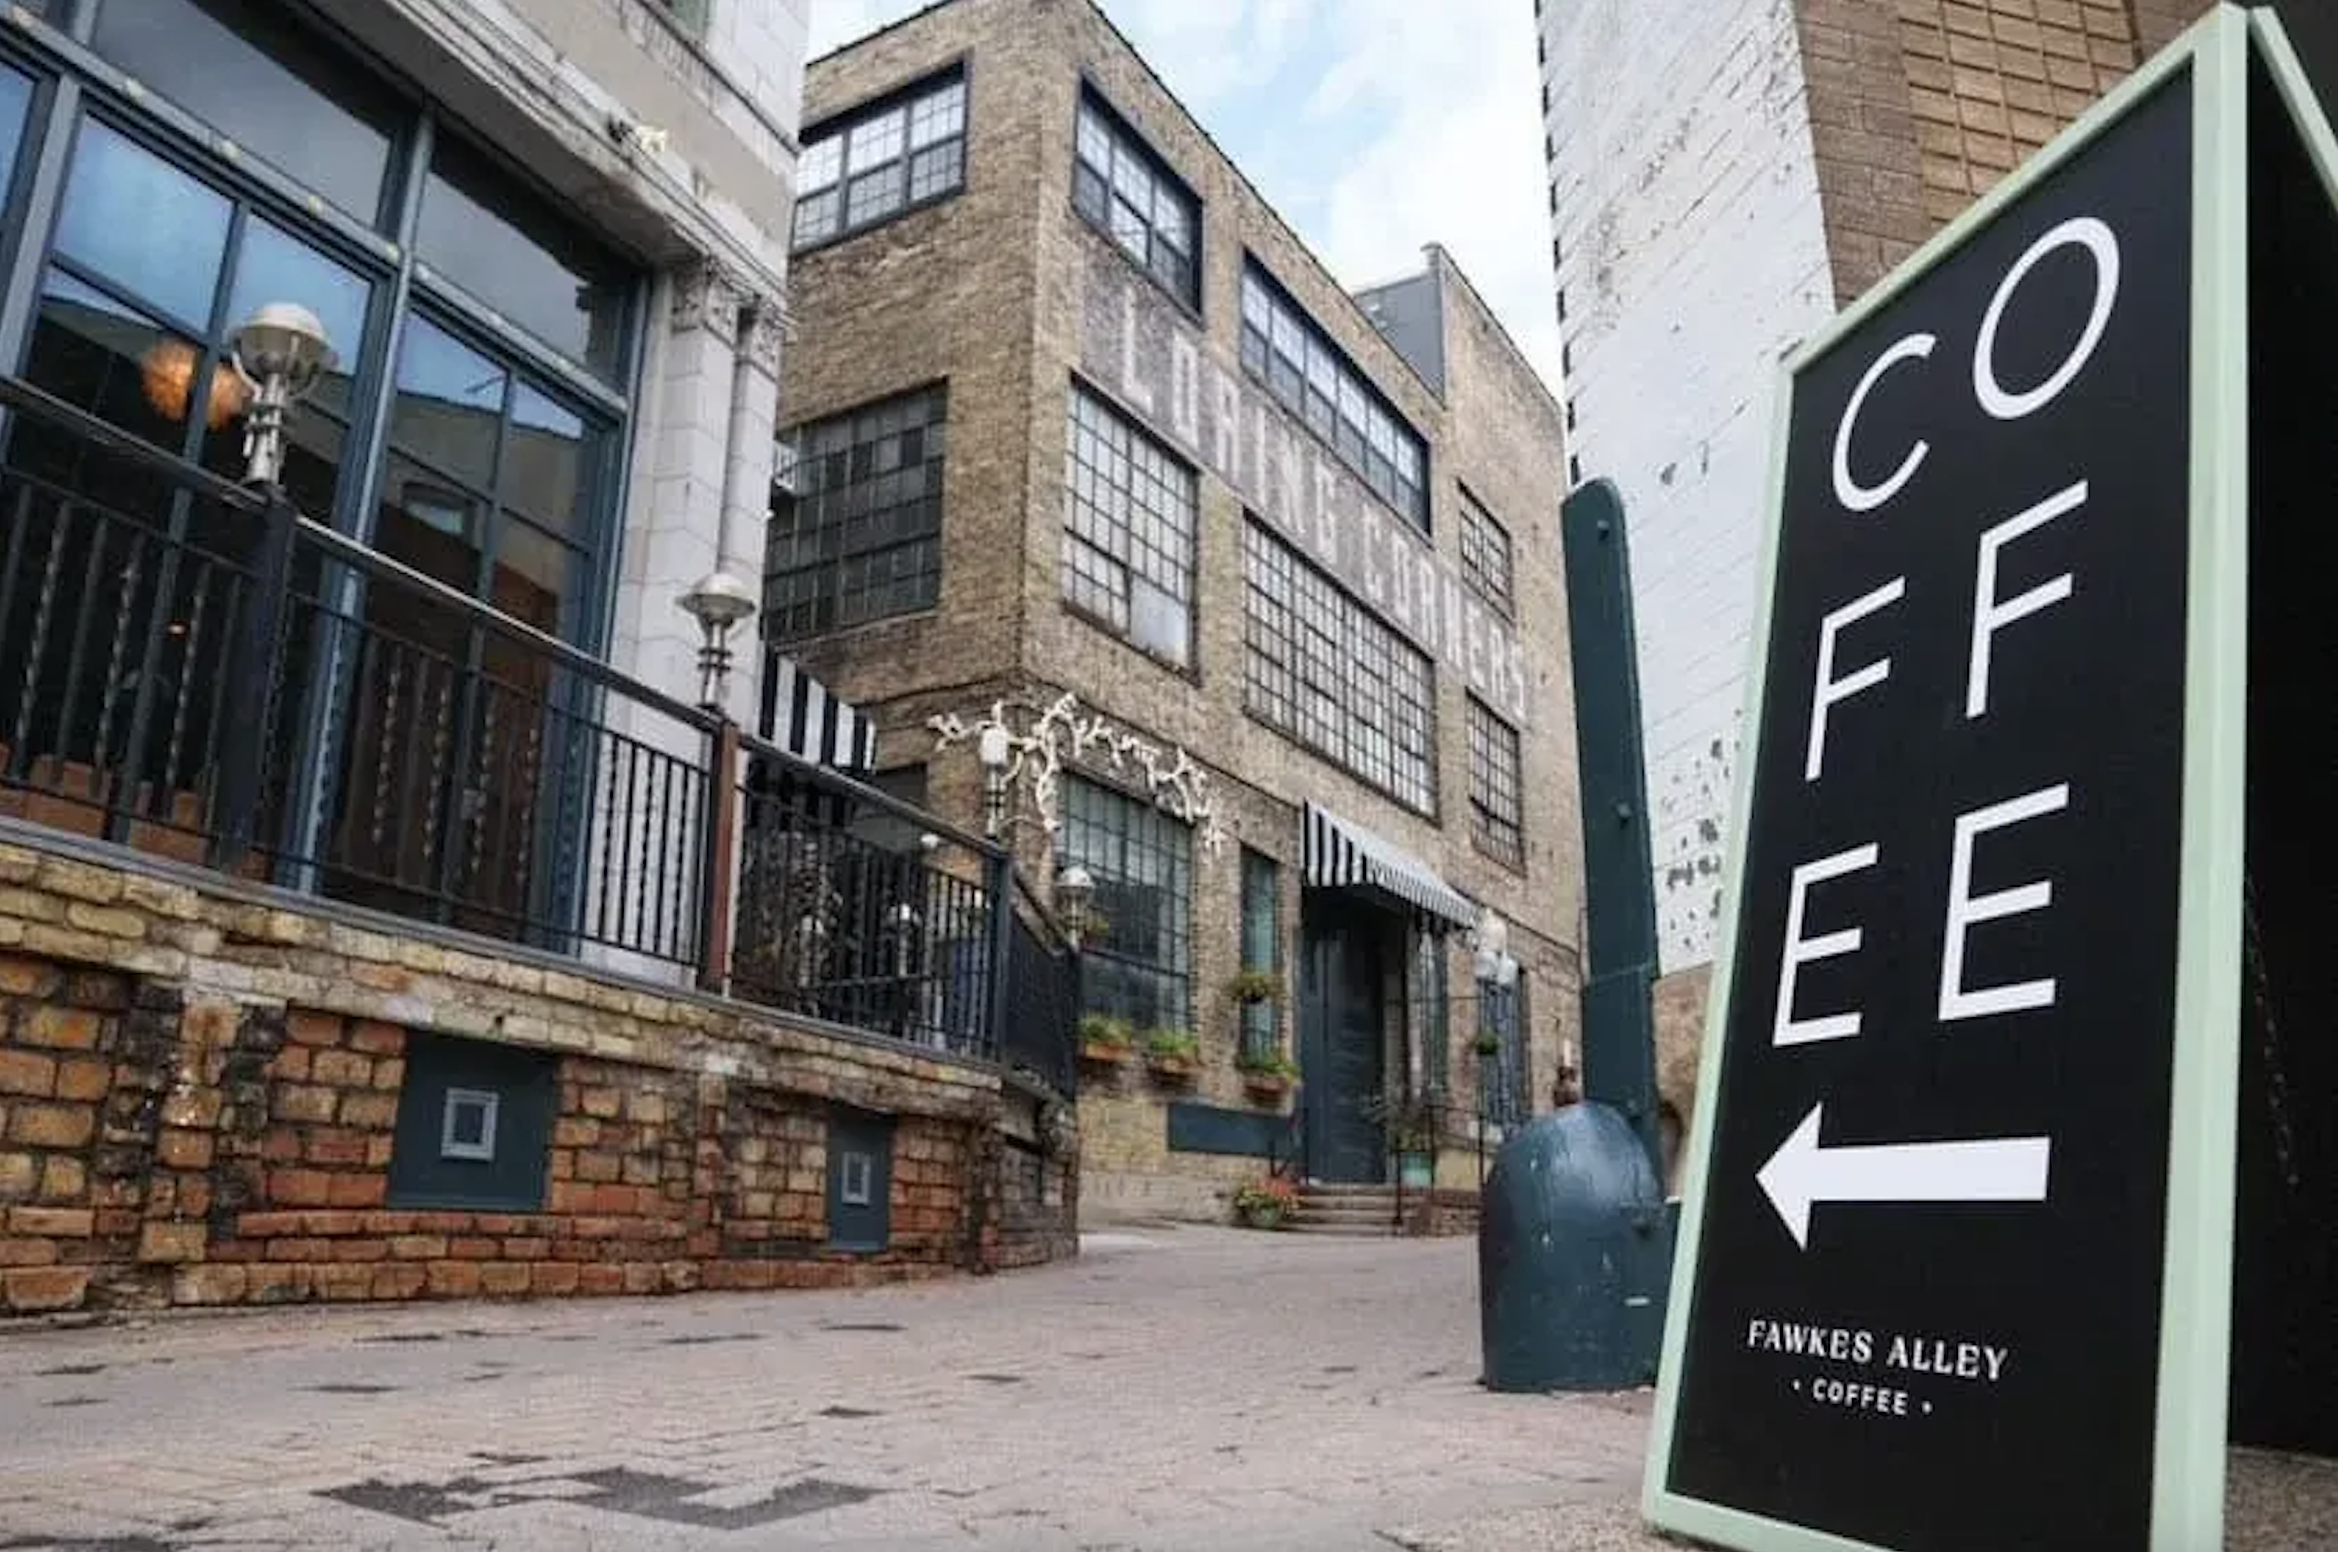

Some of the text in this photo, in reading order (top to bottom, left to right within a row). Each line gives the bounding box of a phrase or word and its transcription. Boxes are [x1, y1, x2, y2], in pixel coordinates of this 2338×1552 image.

[1121, 283, 1526, 719] LORING CORNERS
[1747, 1319, 2008, 1381] FAWKES ALLEY
[1812, 1378, 1908, 1416] COFFEE
